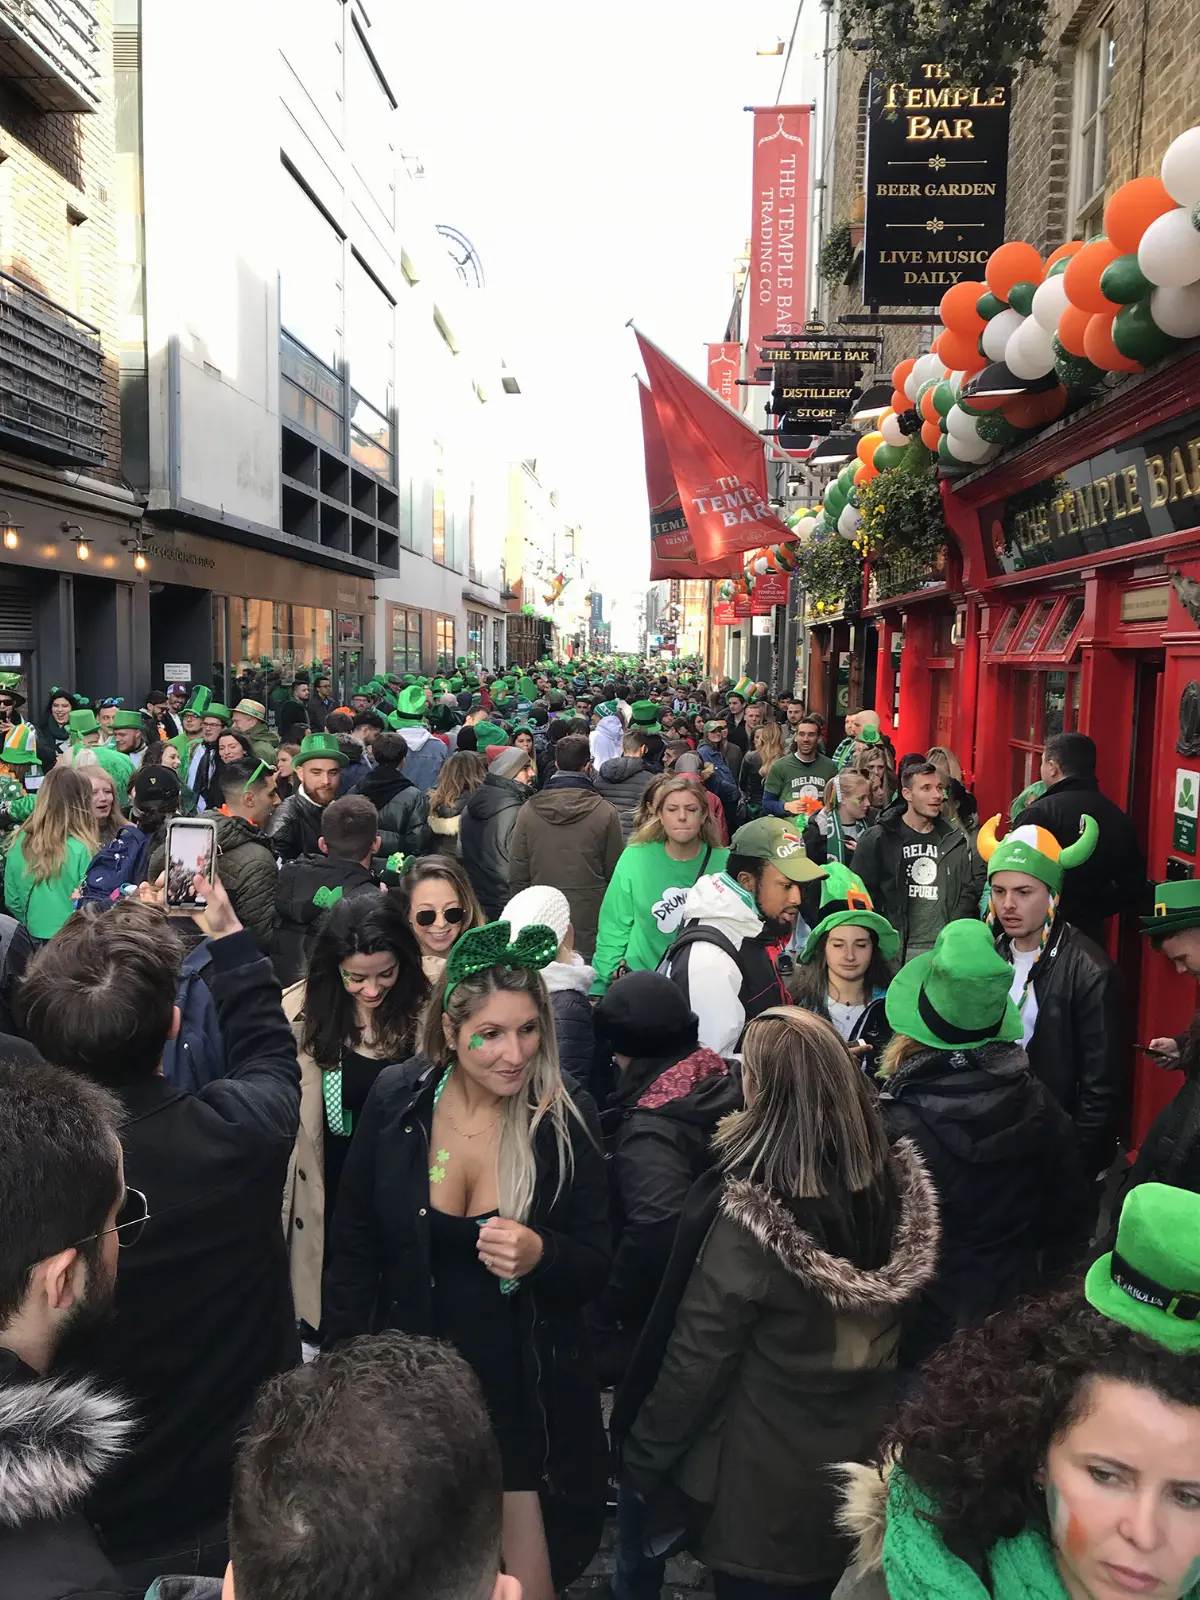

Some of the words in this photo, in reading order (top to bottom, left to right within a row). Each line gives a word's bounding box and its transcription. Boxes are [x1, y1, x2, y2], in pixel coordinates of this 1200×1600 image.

[883, 83, 1006, 108] TEMPLE
[905, 115, 975, 139] BAR
[779, 154, 797, 198] THE
[876, 183, 922, 197] BEER
[924, 183, 997, 197] GARDEN
[760, 187, 774, 274] TRADING
[777, 203, 795, 290] TEMPLE
[879, 250, 923, 264] LIVE
[926, 250, 989, 264] MUSIC
[903, 271, 963, 284] DAILY
[759, 278, 772, 306] CO.
[776, 295, 793, 335] BAR
[767, 350, 791, 360] THE
[793, 350, 841, 361] TEMPLE
[844, 351, 869, 361] BAR
[722, 369, 732, 395] THE
[782, 388, 853, 398] DISTILLERY
[1052, 464, 1143, 538] TEMPLE
[721, 503, 772, 527] BAR
[791, 776, 825, 788] IRELAND
[653, 893, 688, 920] DRUN
